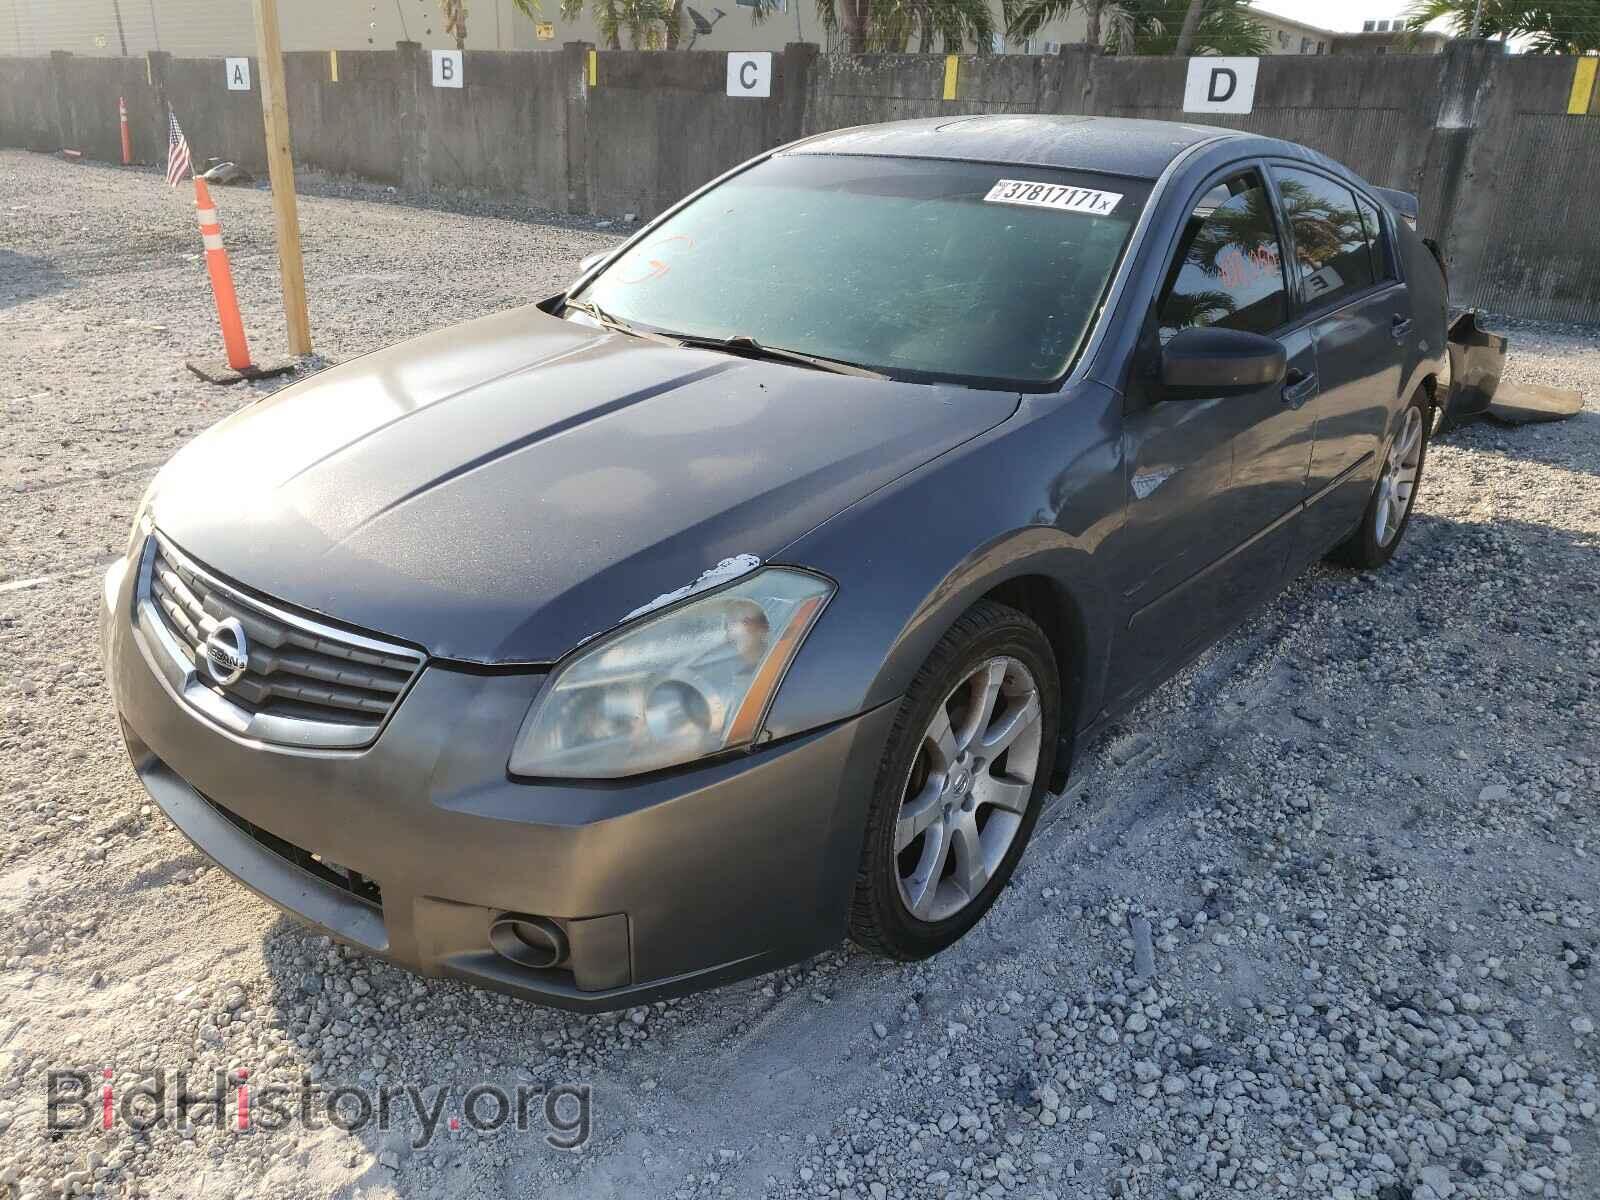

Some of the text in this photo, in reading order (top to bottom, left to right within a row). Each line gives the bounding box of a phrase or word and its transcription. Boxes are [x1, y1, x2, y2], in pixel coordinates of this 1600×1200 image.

[233, 64, 244, 85] A
[442, 56, 453, 80] B
[740, 61, 757, 89] C
[1207, 67, 1238, 102] D
